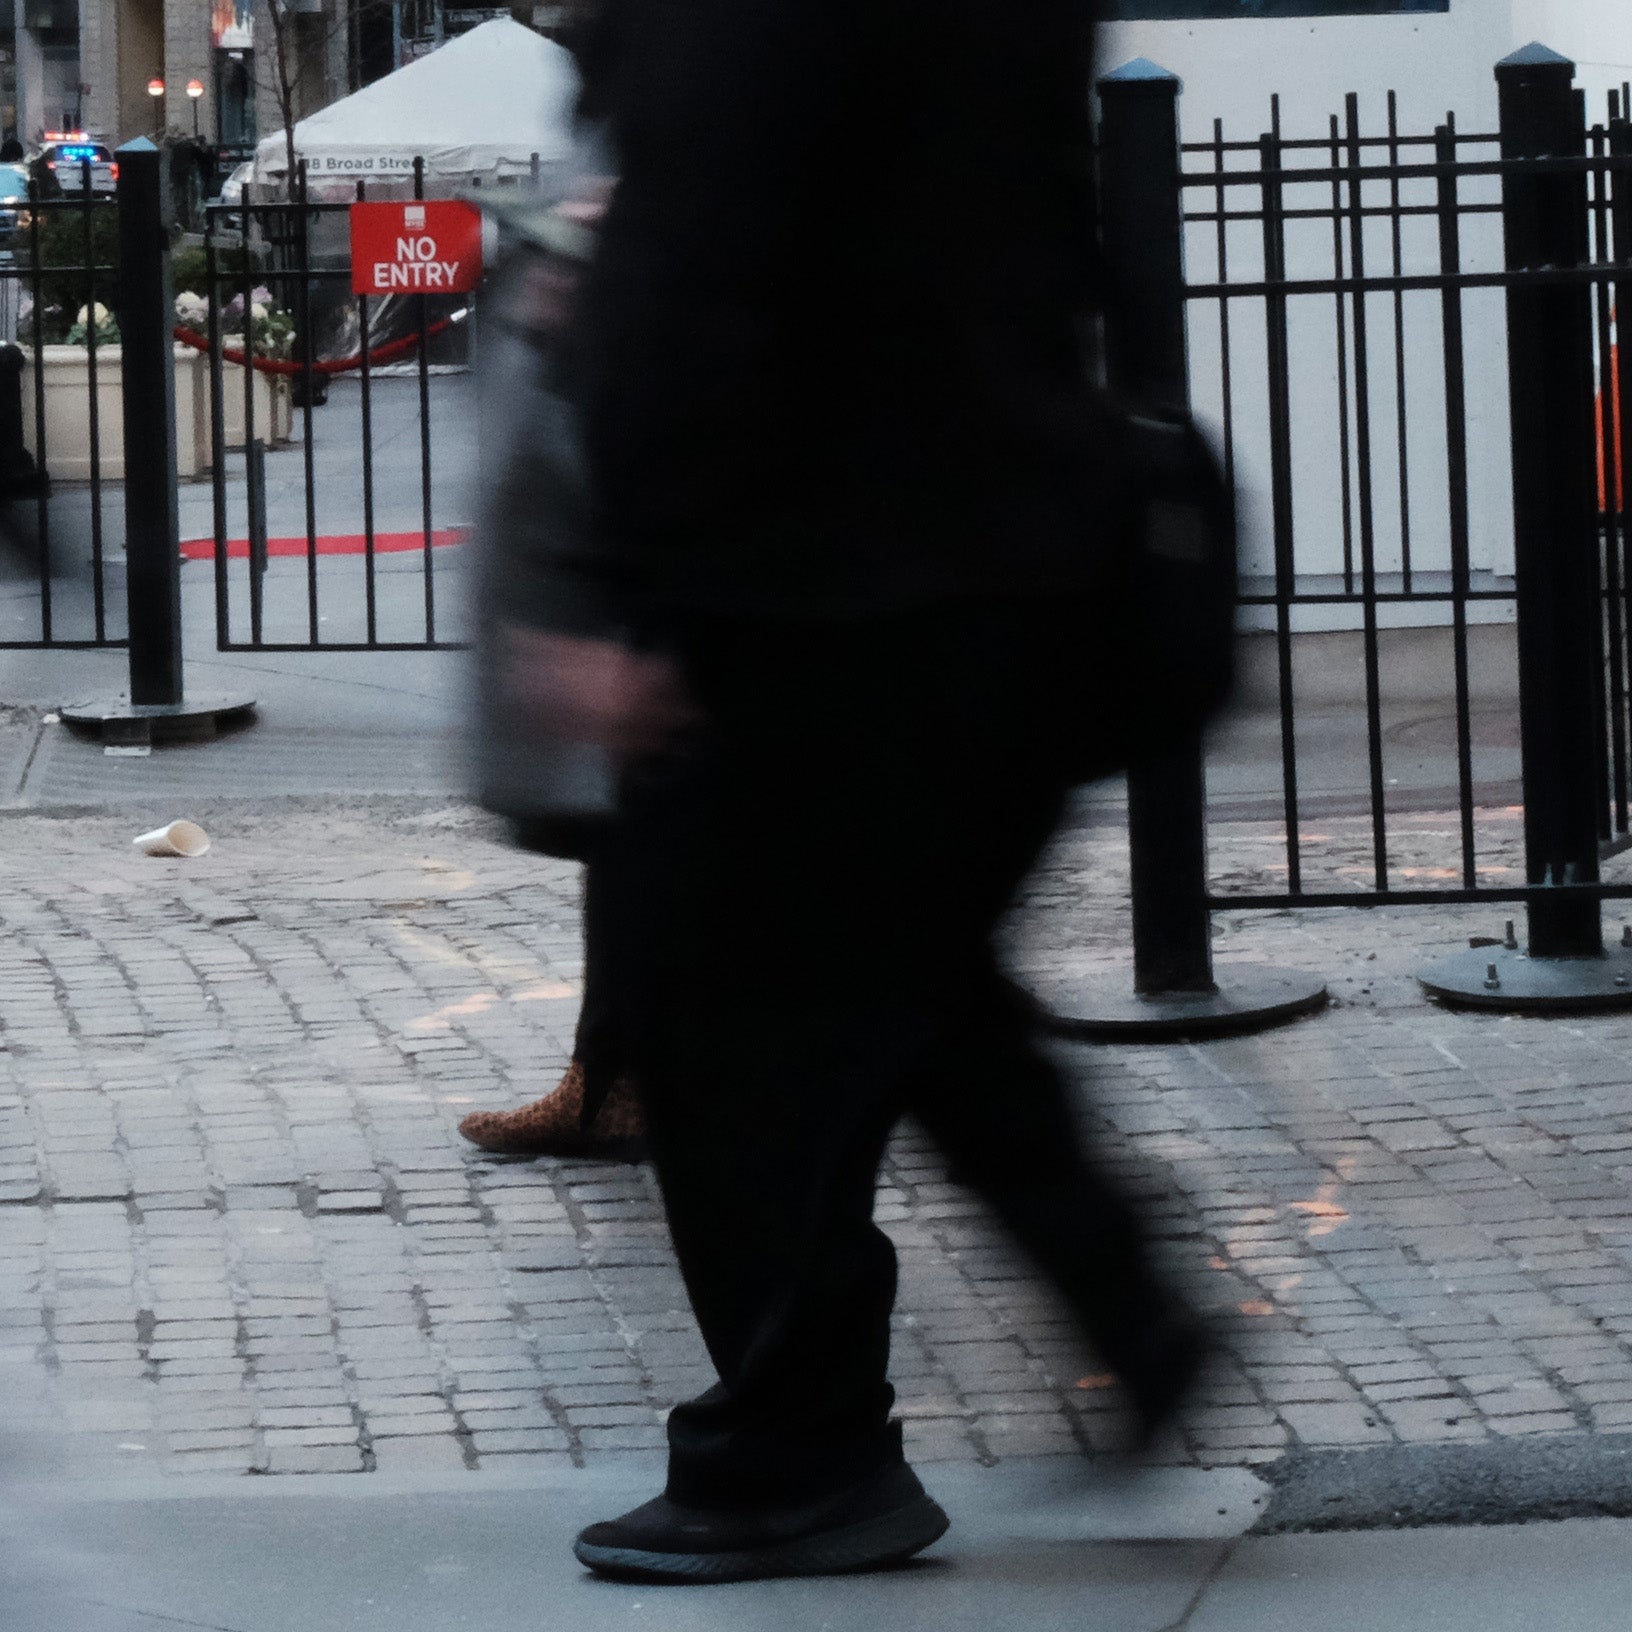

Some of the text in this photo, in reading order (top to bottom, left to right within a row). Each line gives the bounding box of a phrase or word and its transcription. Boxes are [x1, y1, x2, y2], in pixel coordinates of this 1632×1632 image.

[326, 157, 374, 170] Broad
[379, 156, 426, 169] Stre
[396, 236, 437, 262] NO
[373, 262, 460, 288] ENTRY
